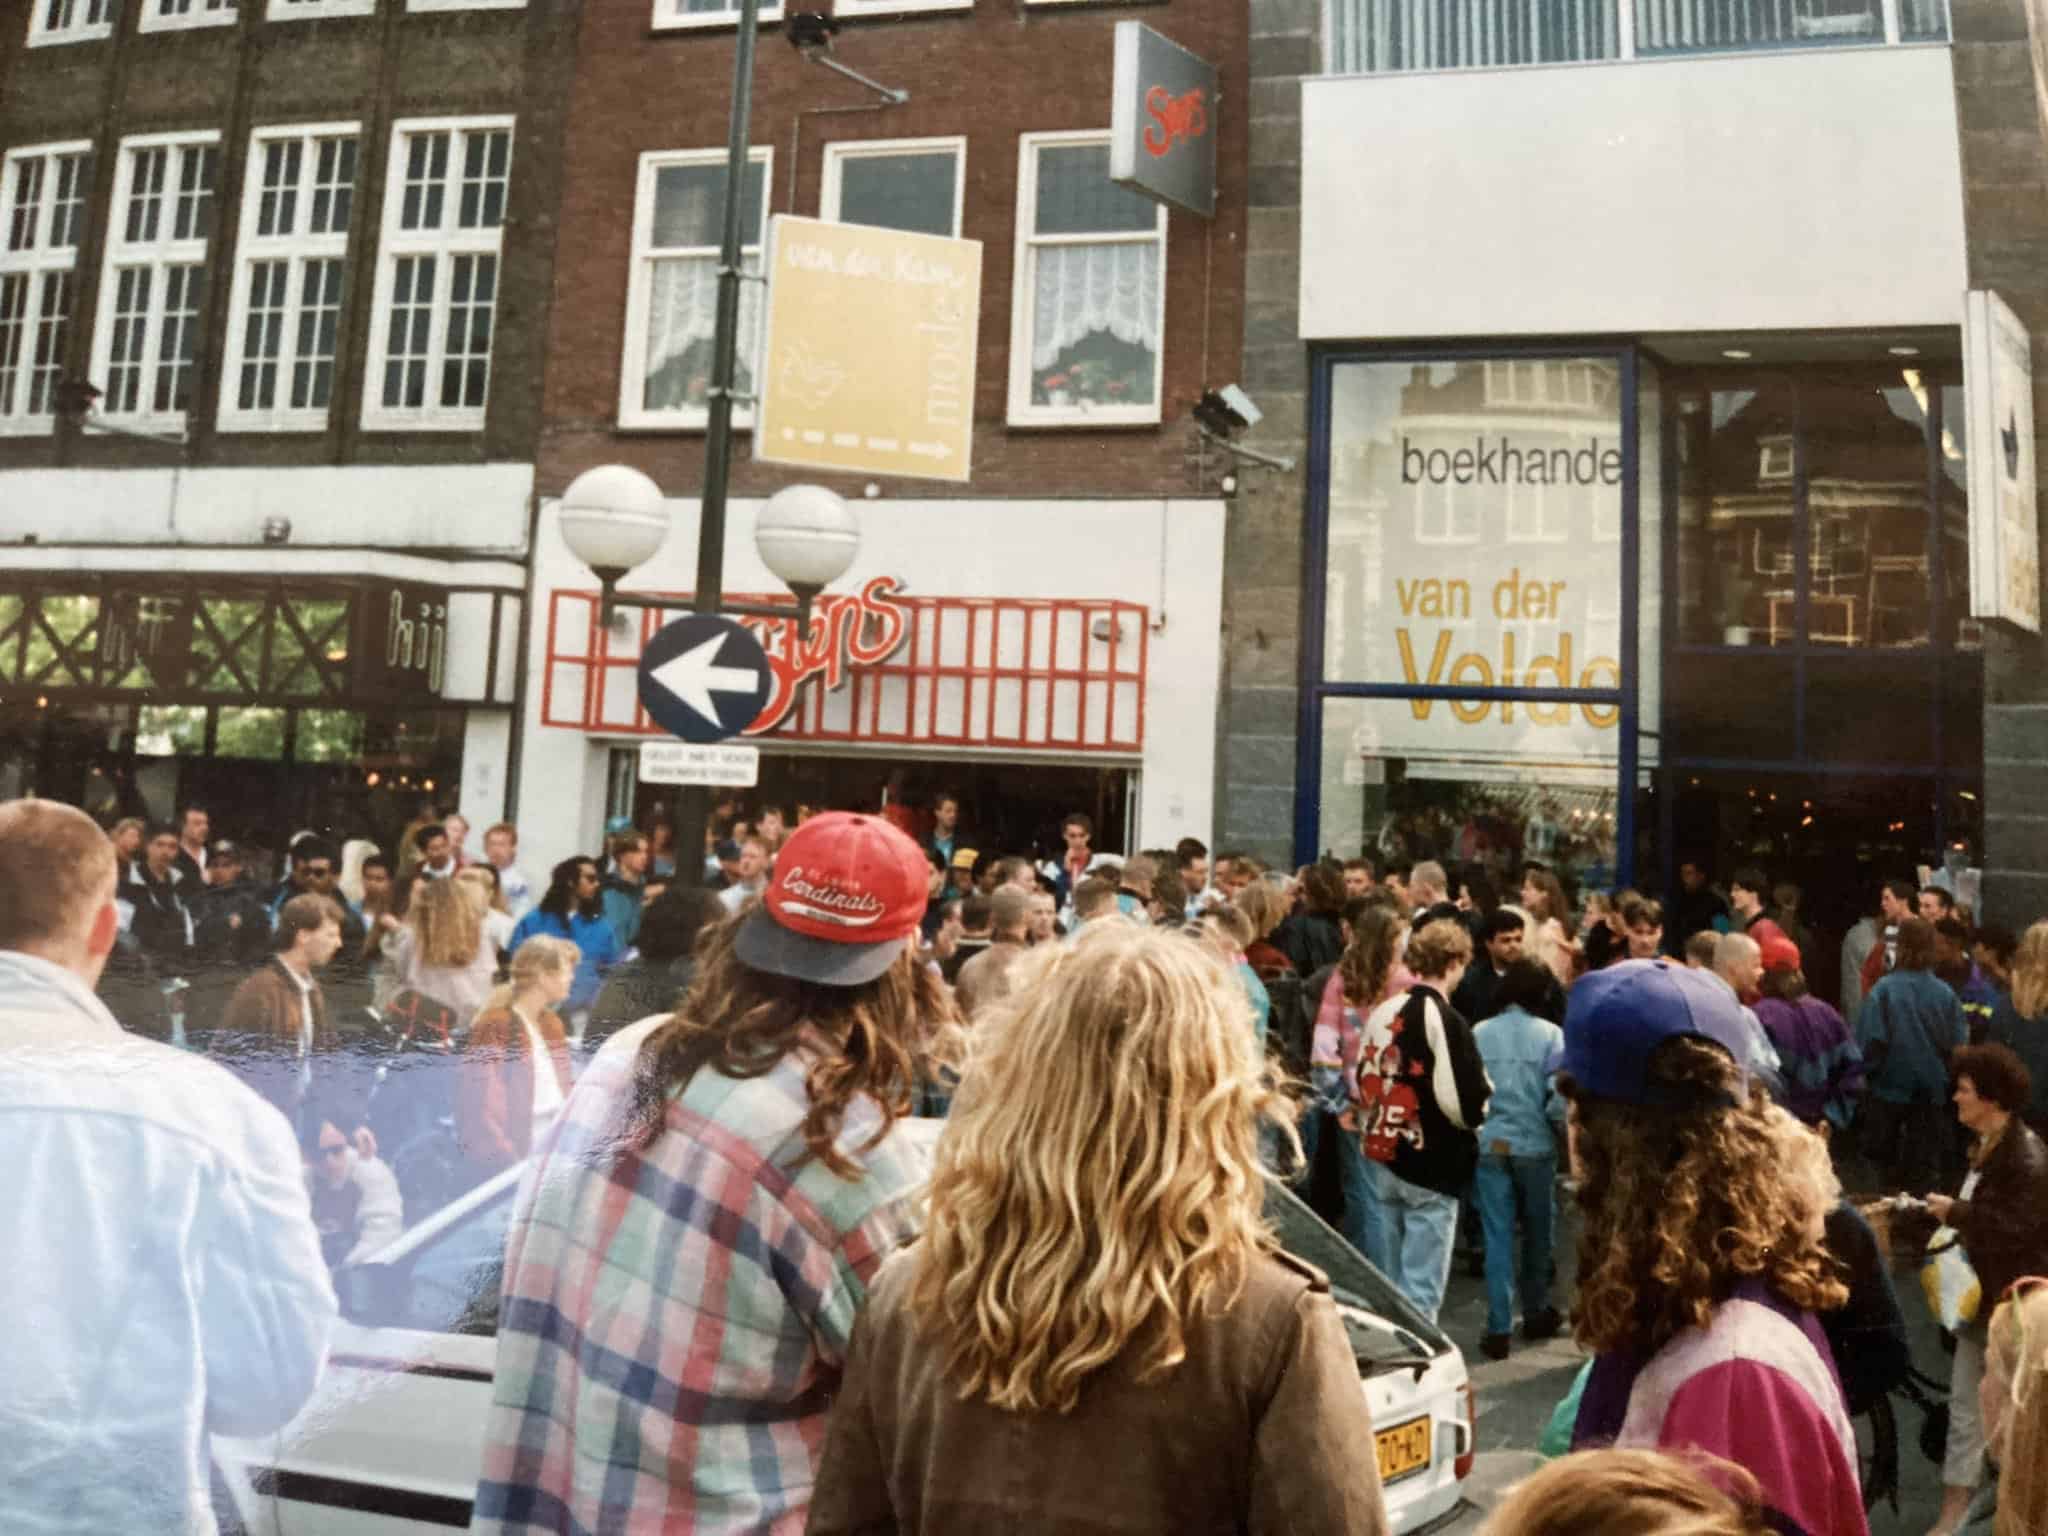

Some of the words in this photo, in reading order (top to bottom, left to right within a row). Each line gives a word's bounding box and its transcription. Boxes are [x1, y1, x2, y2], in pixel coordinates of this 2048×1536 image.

[1401, 436, 1622, 486] boekhande
[1395, 576, 1472, 619] van
[1491, 567, 1567, 620] der
[783, 865, 882, 912] Cardinals
